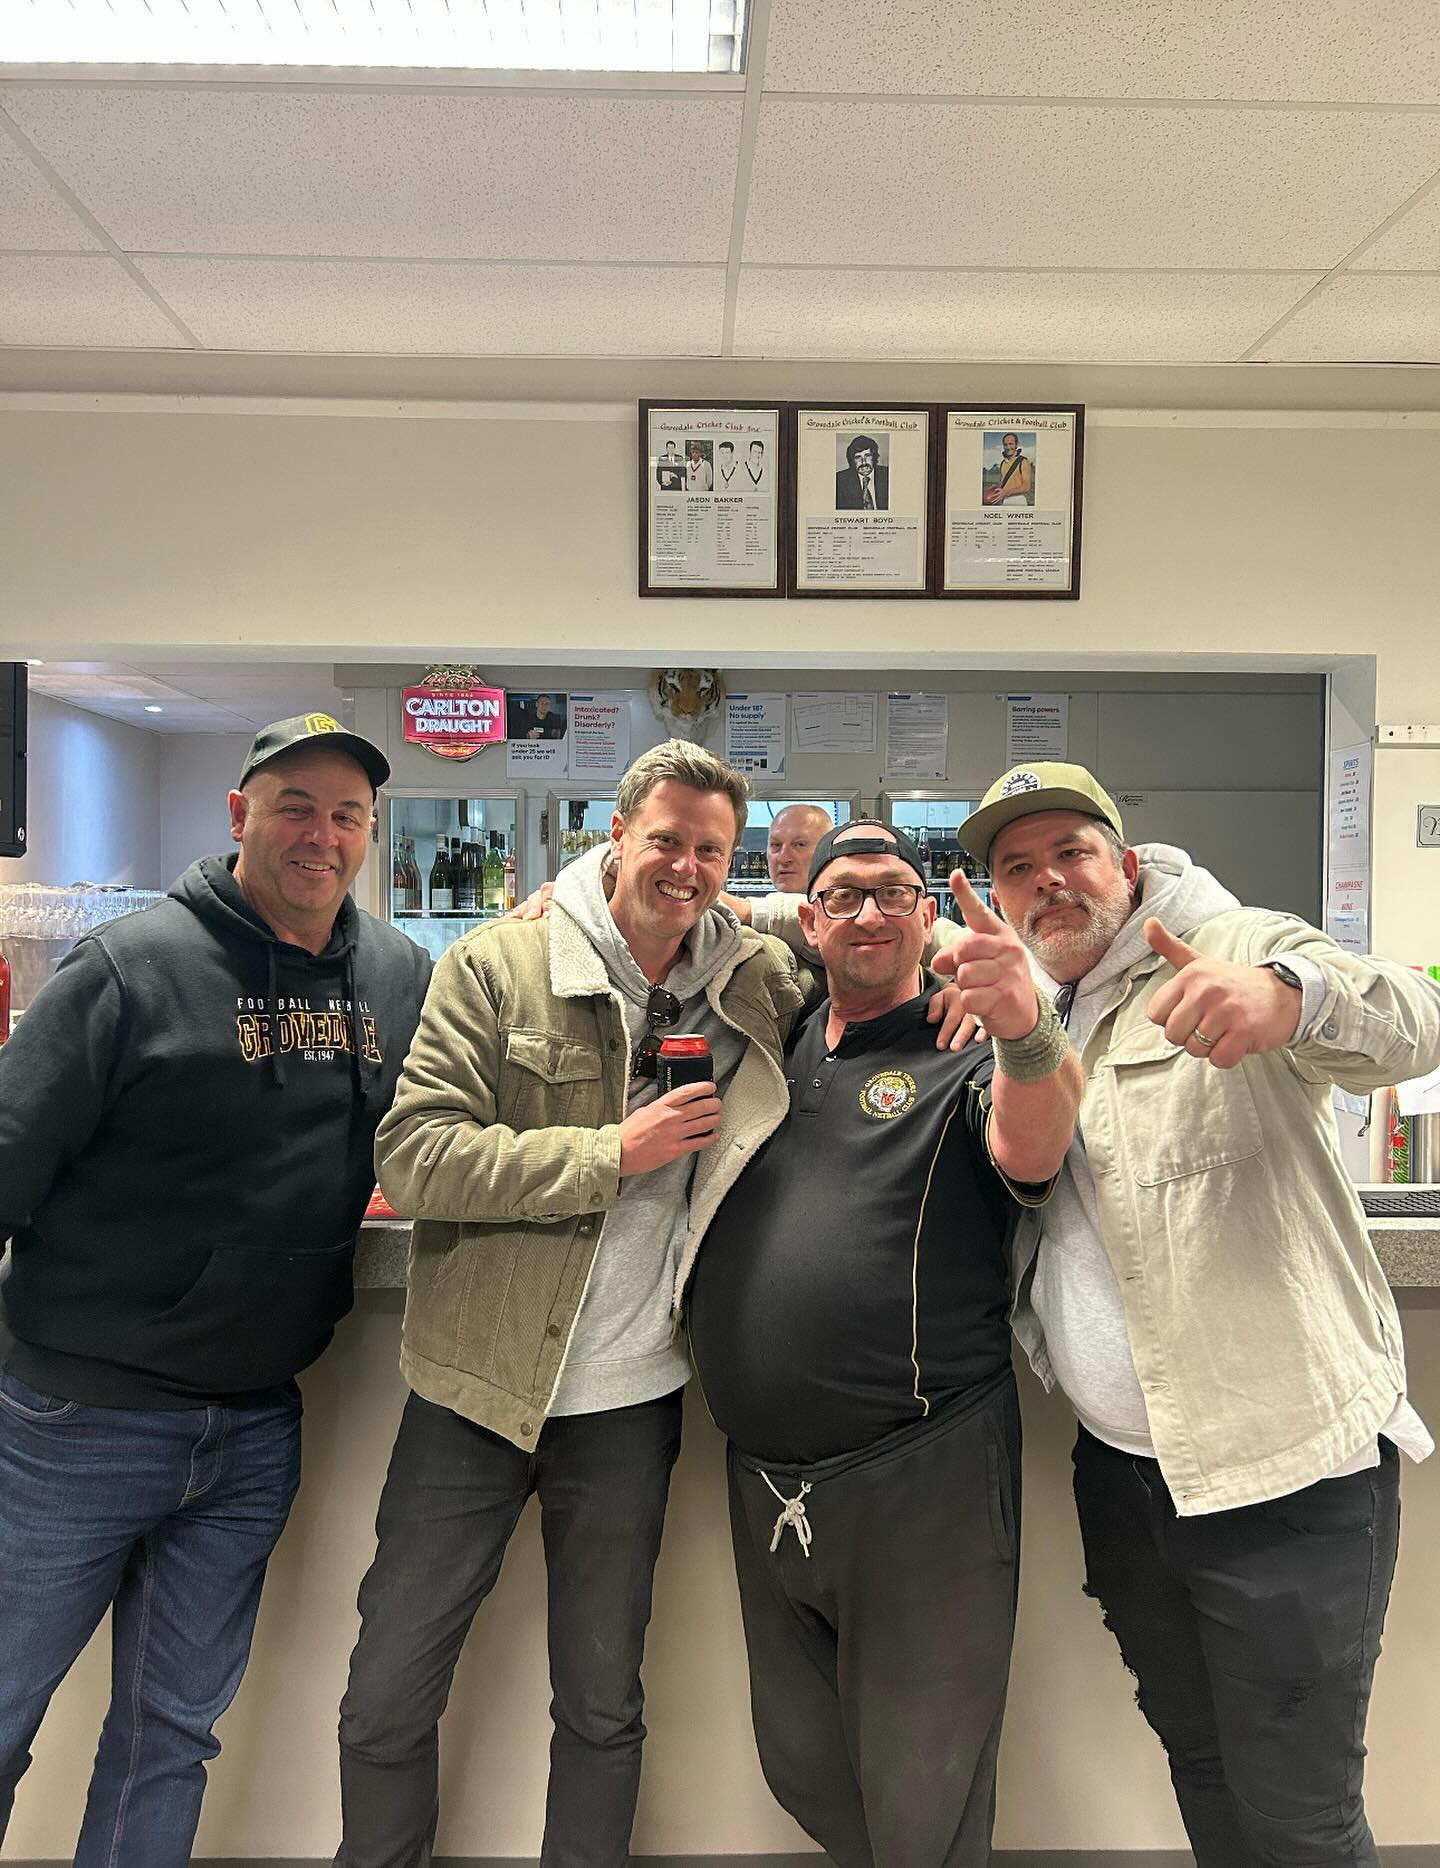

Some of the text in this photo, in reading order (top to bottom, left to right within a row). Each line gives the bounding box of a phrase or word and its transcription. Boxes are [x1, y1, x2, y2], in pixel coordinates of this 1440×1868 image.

[696, 420, 723, 429] Cricket
[725, 421, 744, 431] Club
[806, 418, 841, 428] Grovedale
[900, 420, 919, 429] Club
[988, 417, 1014, 426] Cricket
[1022, 417, 1048, 428] Football
[1050, 421, 1067, 429] Club
[405, 697, 500, 717] CARLTON
[574, 706, 620, 714] Intoxicated?
[574, 713, 601, 721] Drunk?
[740, 712, 766, 720] supply
[415, 717, 493, 733] DRAUGHT
[574, 720, 616, 729] Disorderly?
[328, 998, 371, 1013] NETBLL
